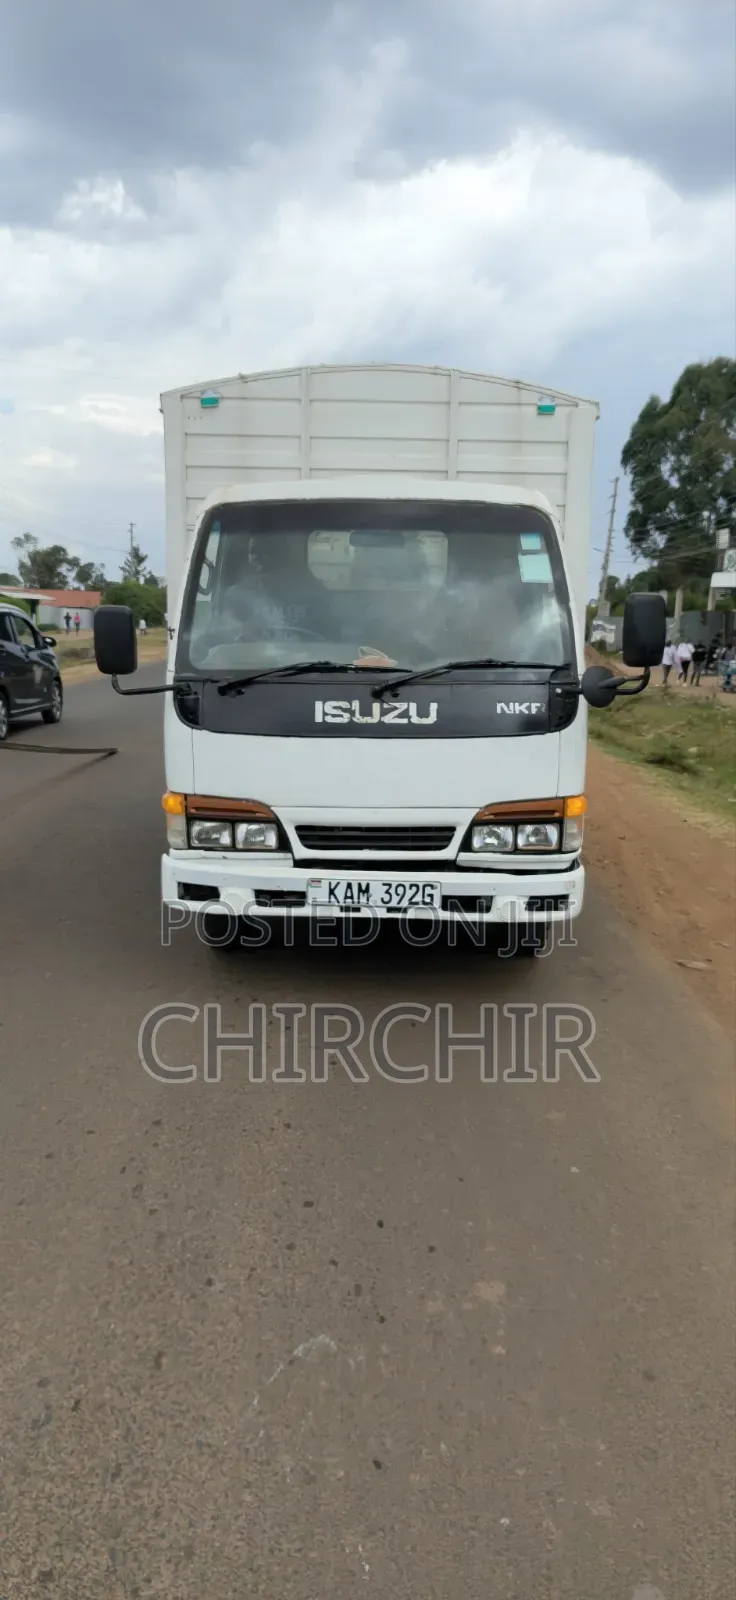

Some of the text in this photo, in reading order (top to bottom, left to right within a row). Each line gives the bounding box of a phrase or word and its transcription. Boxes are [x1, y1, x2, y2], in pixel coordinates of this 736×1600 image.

[315, 700, 438, 724] ISUZU
[328, 881, 436, 906] KAM 392G
